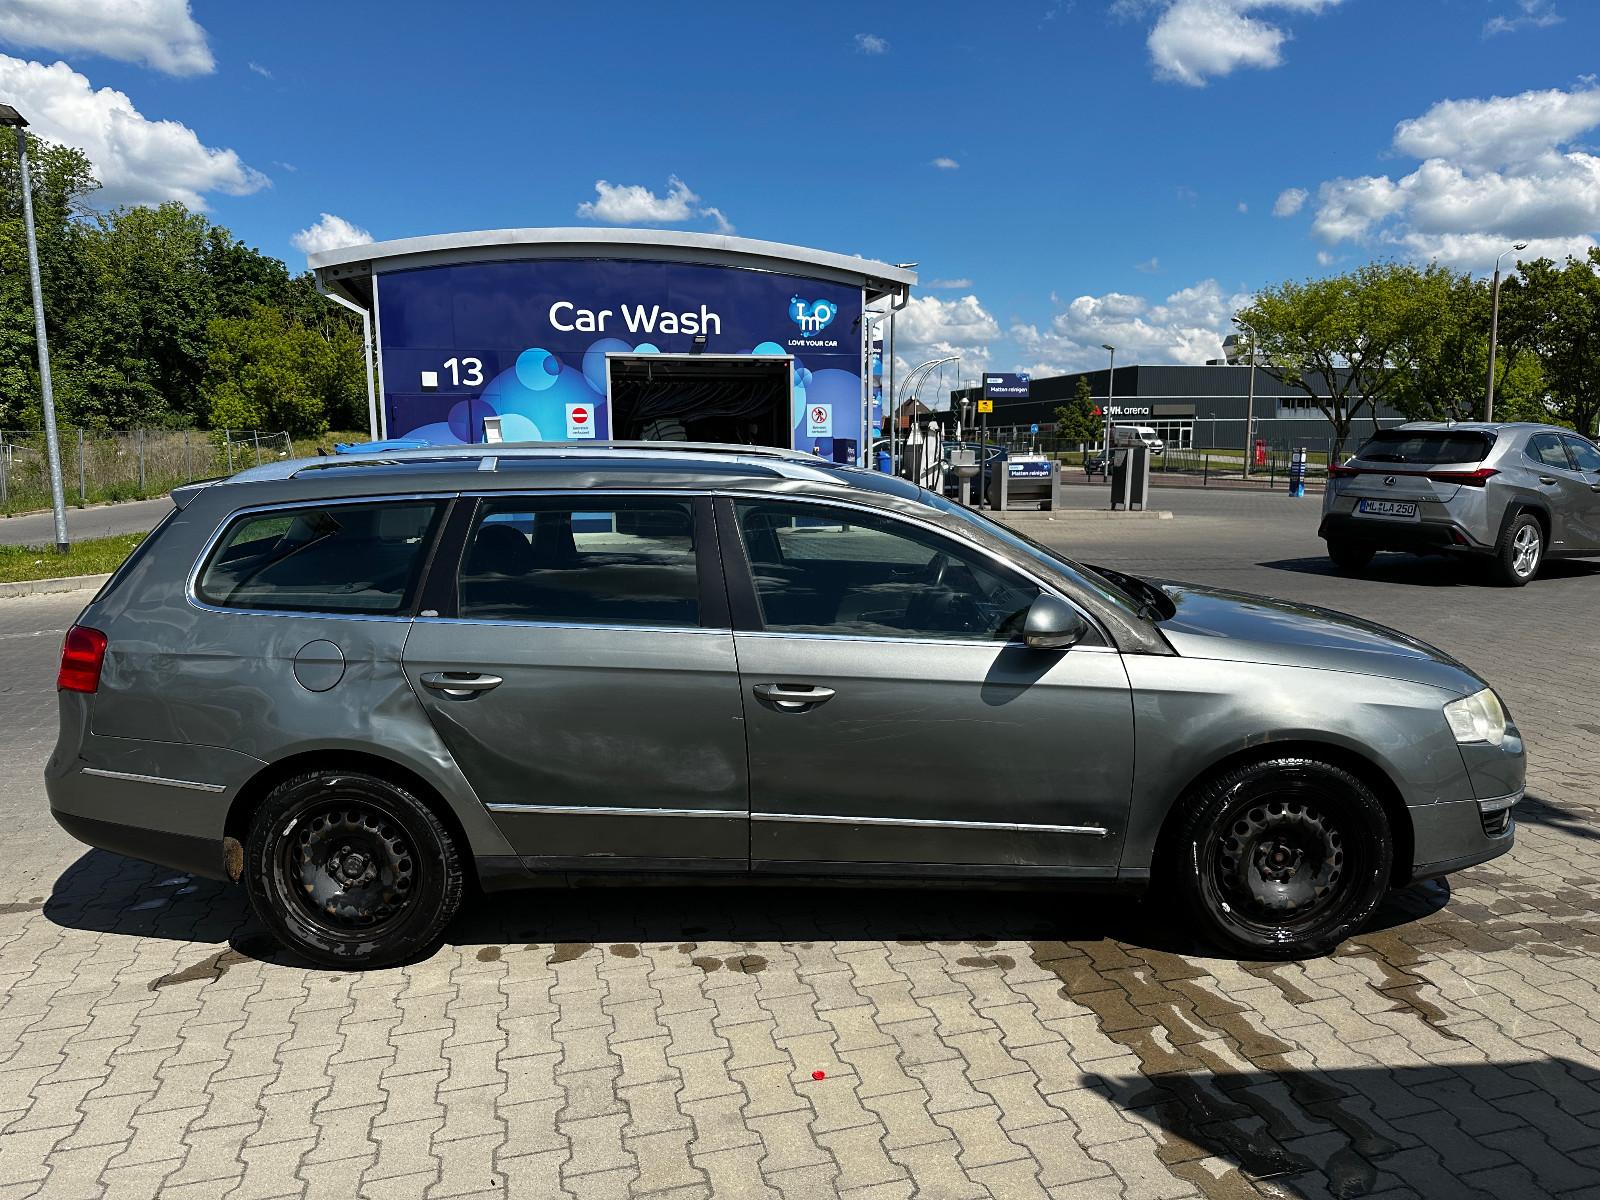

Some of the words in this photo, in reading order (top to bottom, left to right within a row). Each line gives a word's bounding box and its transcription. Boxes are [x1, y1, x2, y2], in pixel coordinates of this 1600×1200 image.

[549, 301, 613, 332] Car
[620, 303, 721, 335] Wash
[443, 357, 484, 386] 13
[1123, 407, 1149, 415] arena
[1365, 500, 1377, 511] ML
[1382, 502, 1394, 512] LA
[1395, 504, 1414, 514] 250
